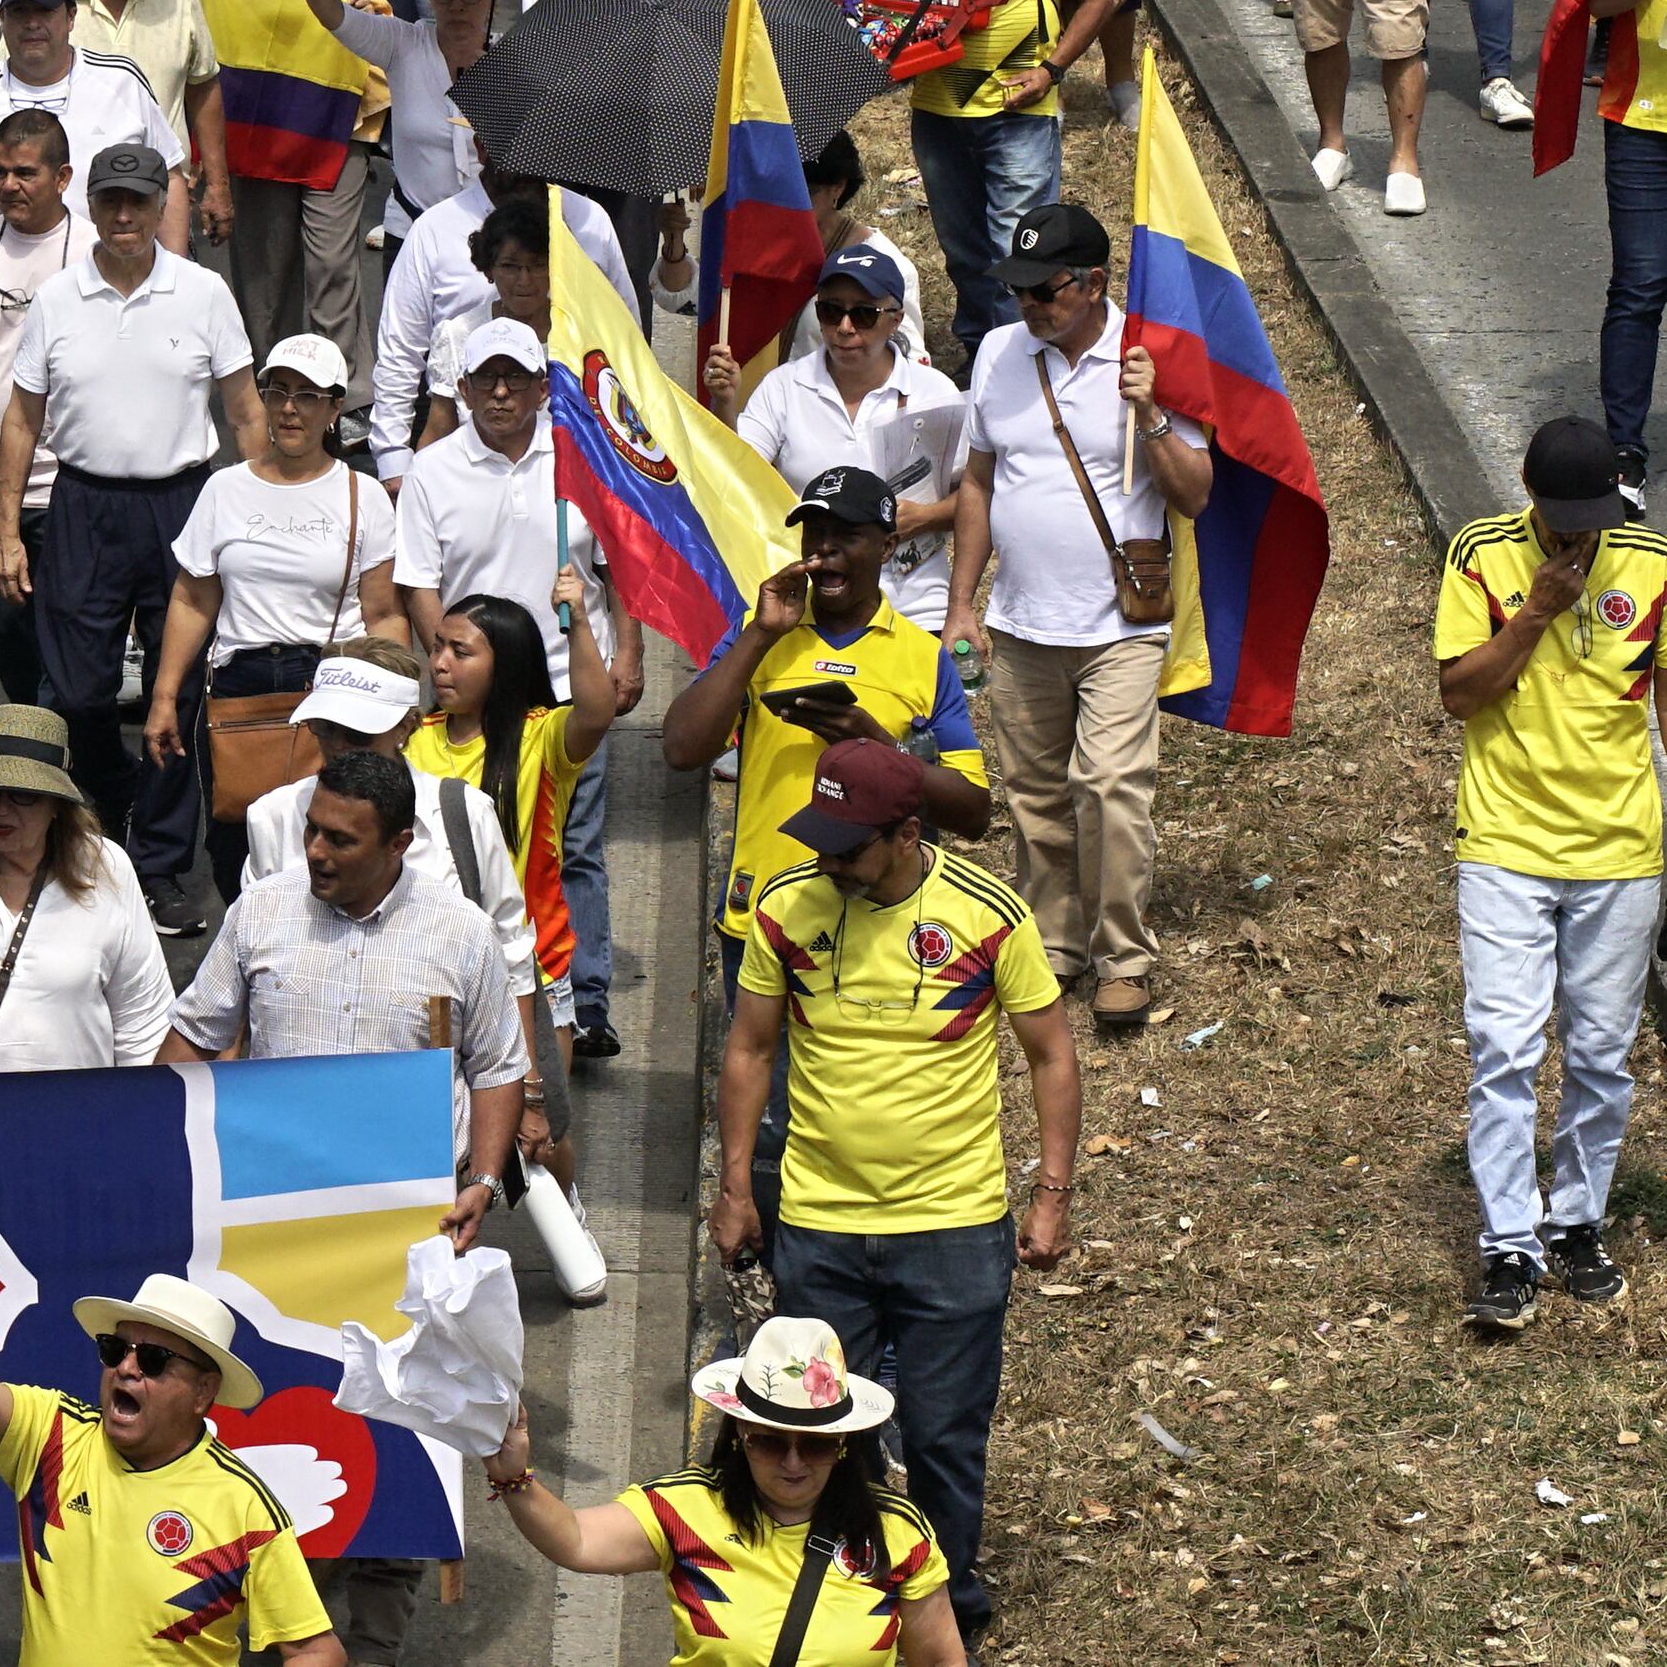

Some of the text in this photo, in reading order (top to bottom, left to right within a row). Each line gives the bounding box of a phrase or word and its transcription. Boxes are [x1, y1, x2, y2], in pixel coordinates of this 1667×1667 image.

[827, 664, 855, 674] lotto
[316, 667, 382, 695] Titleist
[67, 1502, 92, 1516] adidas
